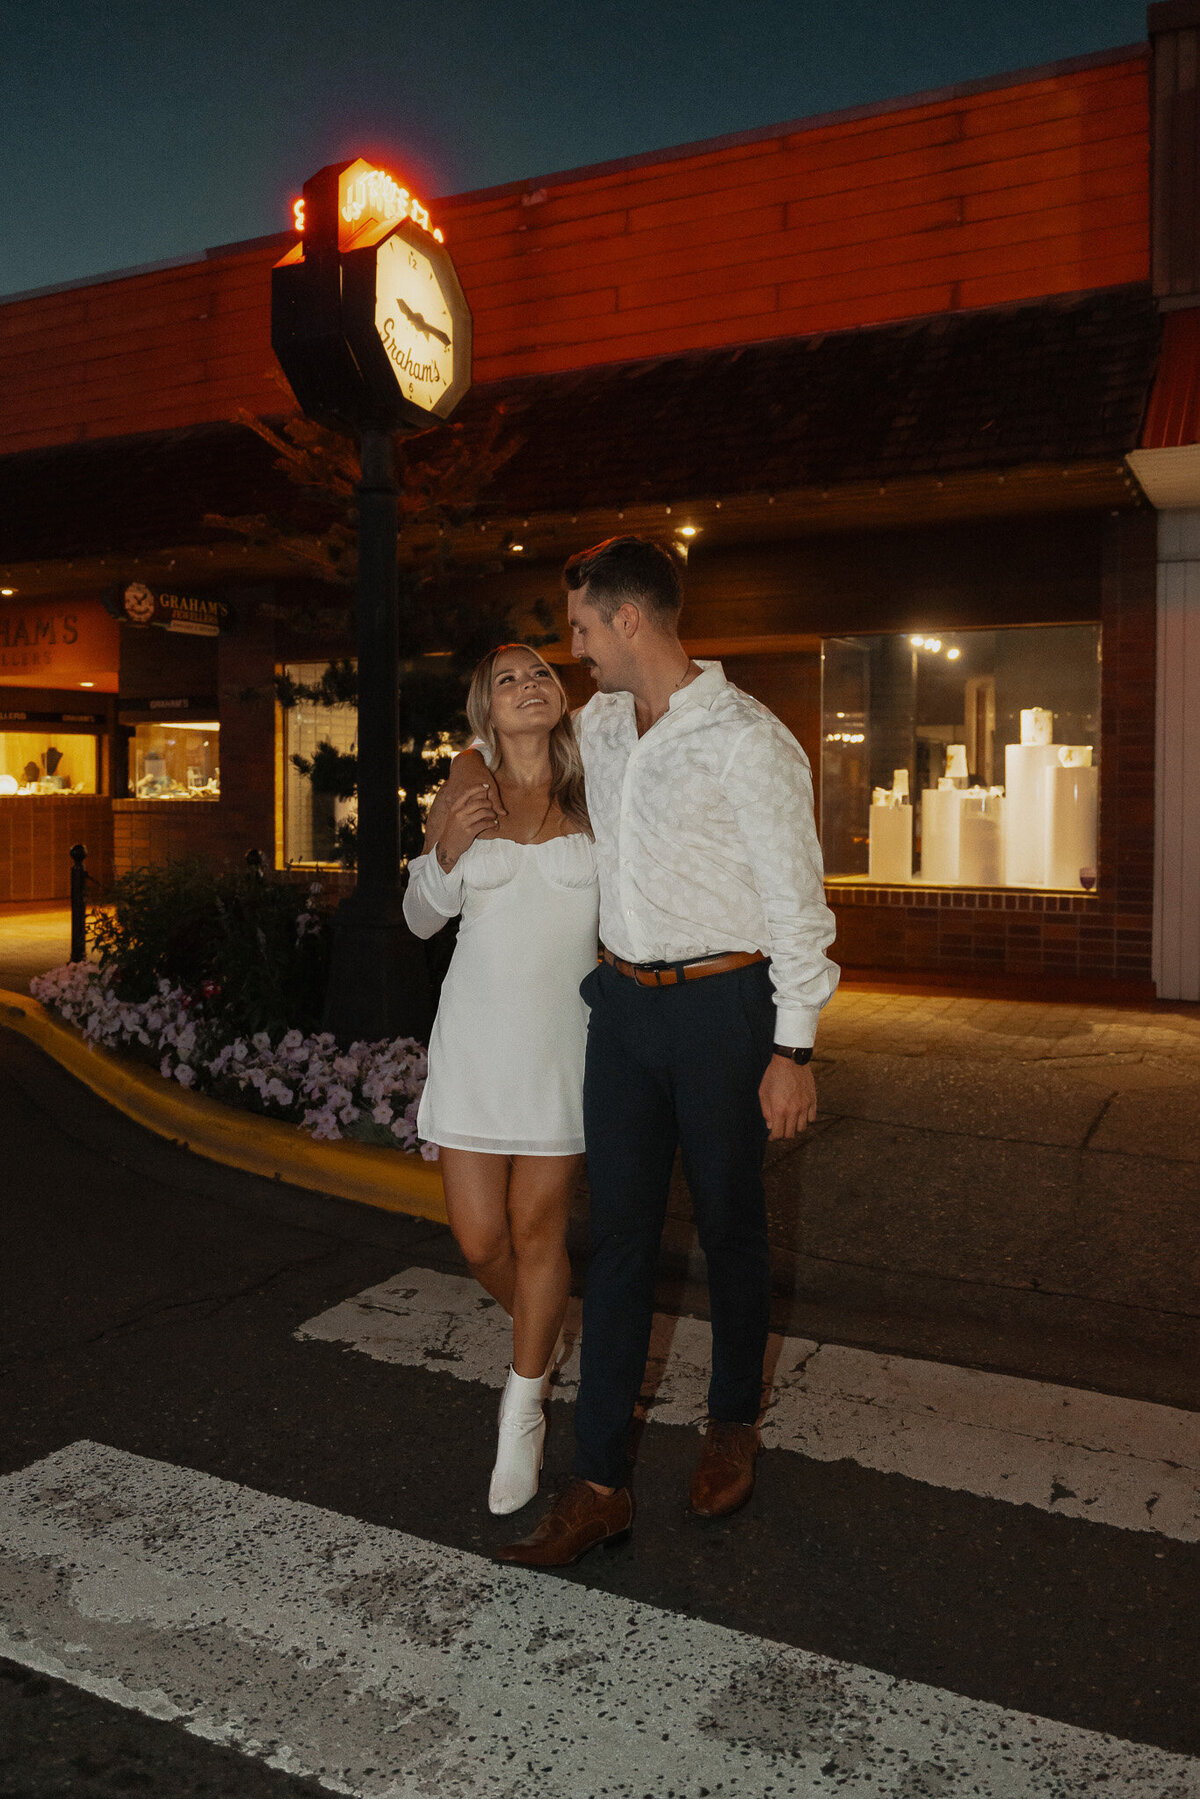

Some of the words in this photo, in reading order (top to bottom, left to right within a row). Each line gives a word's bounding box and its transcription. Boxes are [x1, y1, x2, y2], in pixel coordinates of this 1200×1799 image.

[407, 255, 418, 270] 12
[382, 317, 440, 383] Graham's
[408, 382, 415, 393] 6
[159, 592, 229, 617] GRAHAM'S
